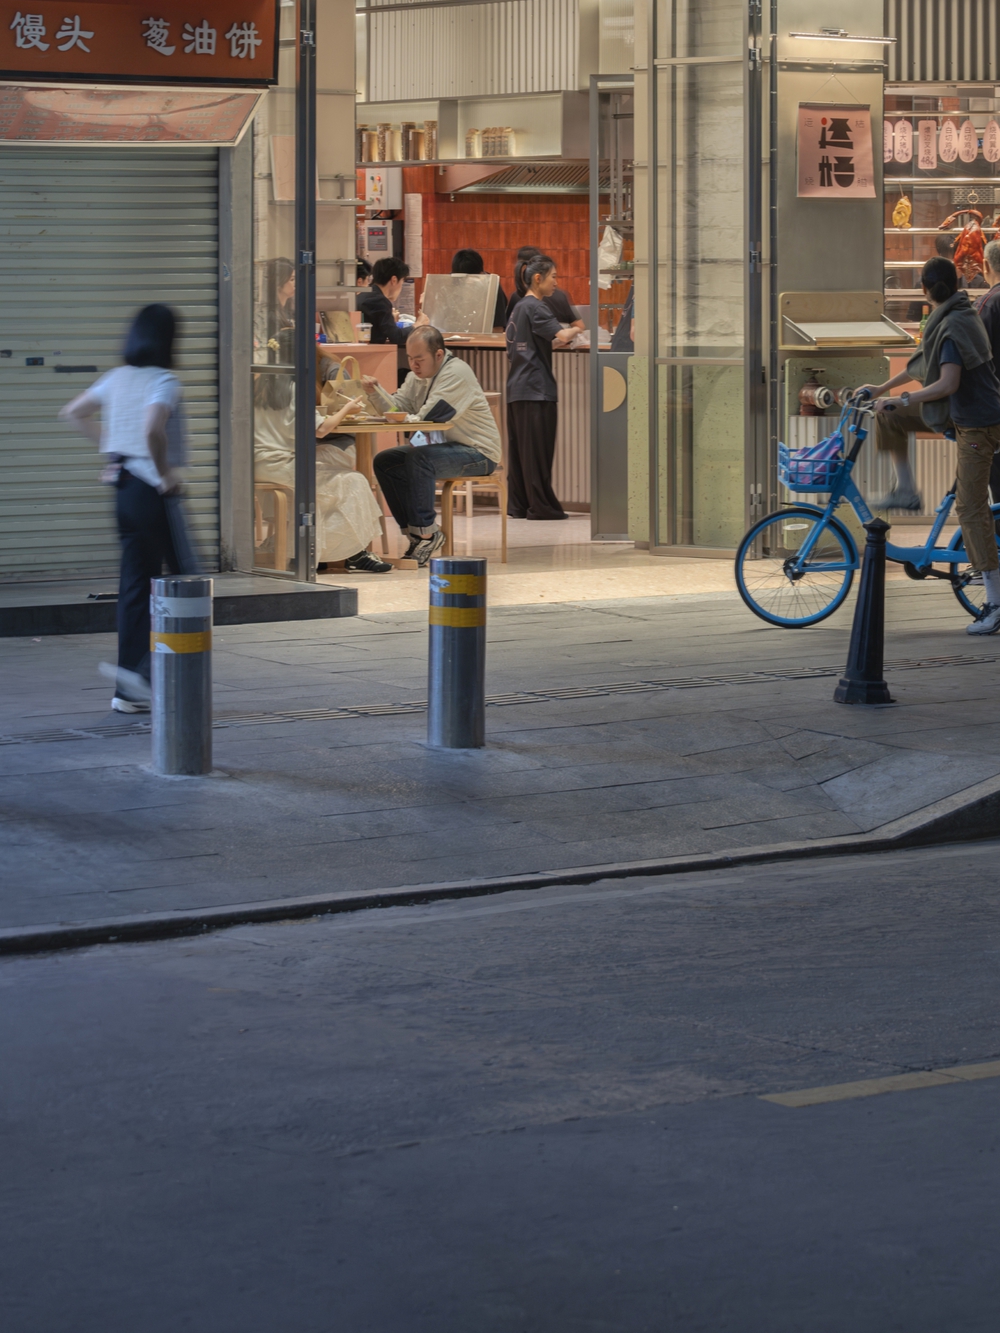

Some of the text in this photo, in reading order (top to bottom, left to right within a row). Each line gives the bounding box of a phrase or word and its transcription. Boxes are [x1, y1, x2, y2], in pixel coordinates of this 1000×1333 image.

[9, 11, 263, 60] 馒头 葱油饼
